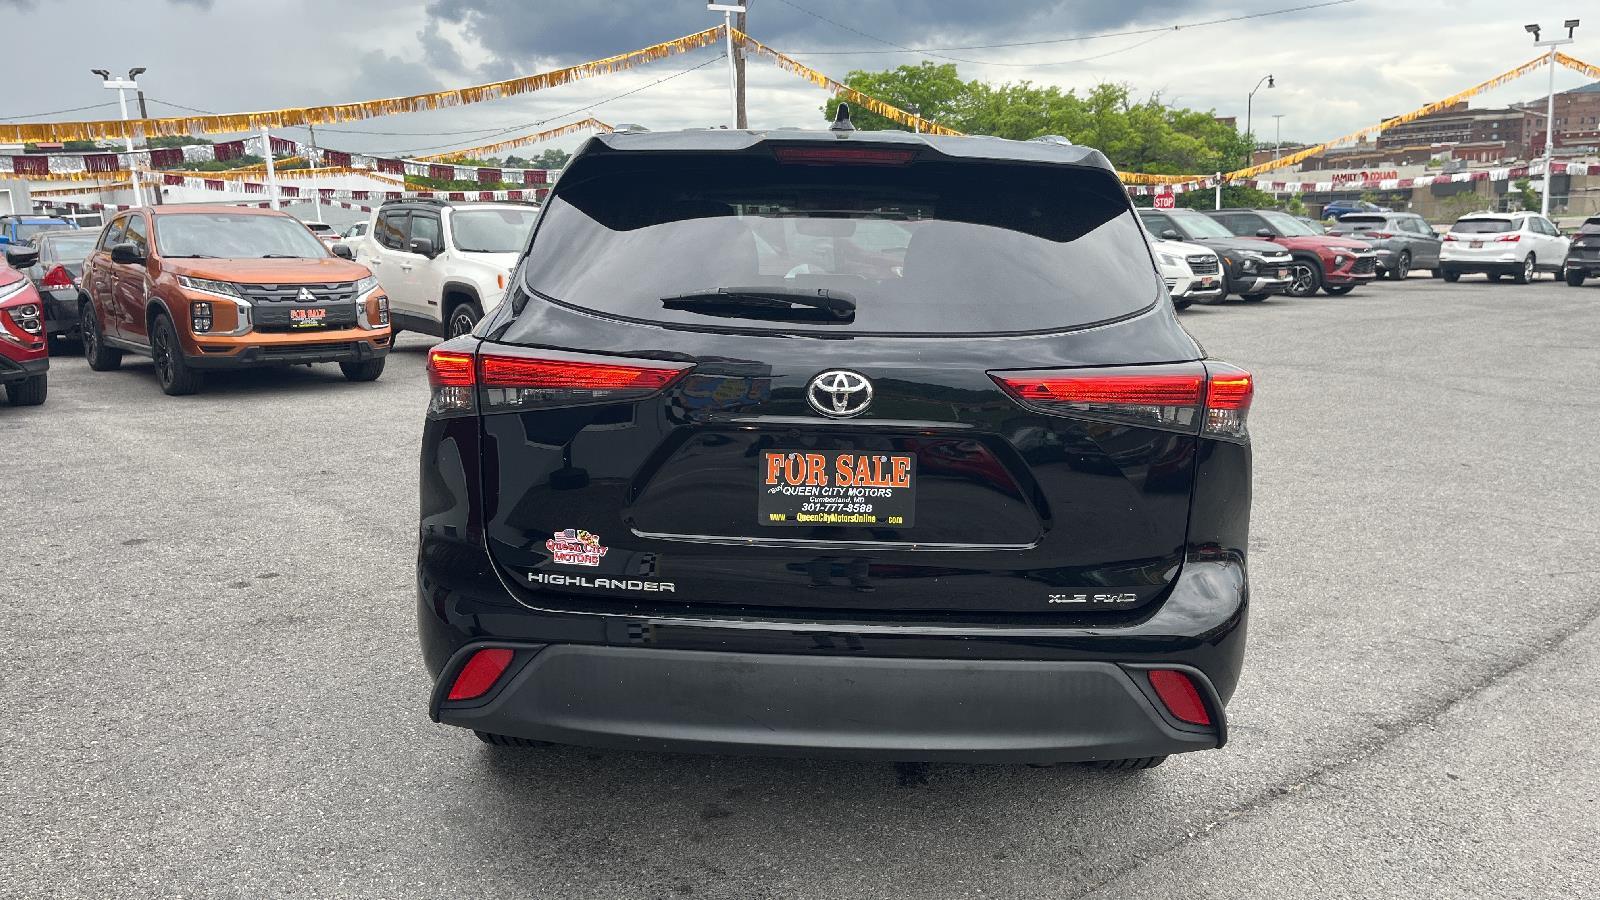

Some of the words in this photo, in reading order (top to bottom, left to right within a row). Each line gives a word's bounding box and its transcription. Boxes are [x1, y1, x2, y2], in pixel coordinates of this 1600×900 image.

[1155, 197, 1173, 208] STOP
[765, 453, 828, 486] FOR
[835, 454, 911, 488] SALE
[782, 486, 820, 496] QUEEN
[821, 486, 846, 496] CITY
[847, 487, 893, 498] MOTORS
[801, 502, 873, 513] 301-777-8588
[546, 539, 581, 552] Queen
[554, 551, 599, 565] MOTORS
[527, 572, 676, 593] HIGHLANDER
[1048, 594, 1087, 604] XLE
[1093, 593, 1138, 603] AWD
